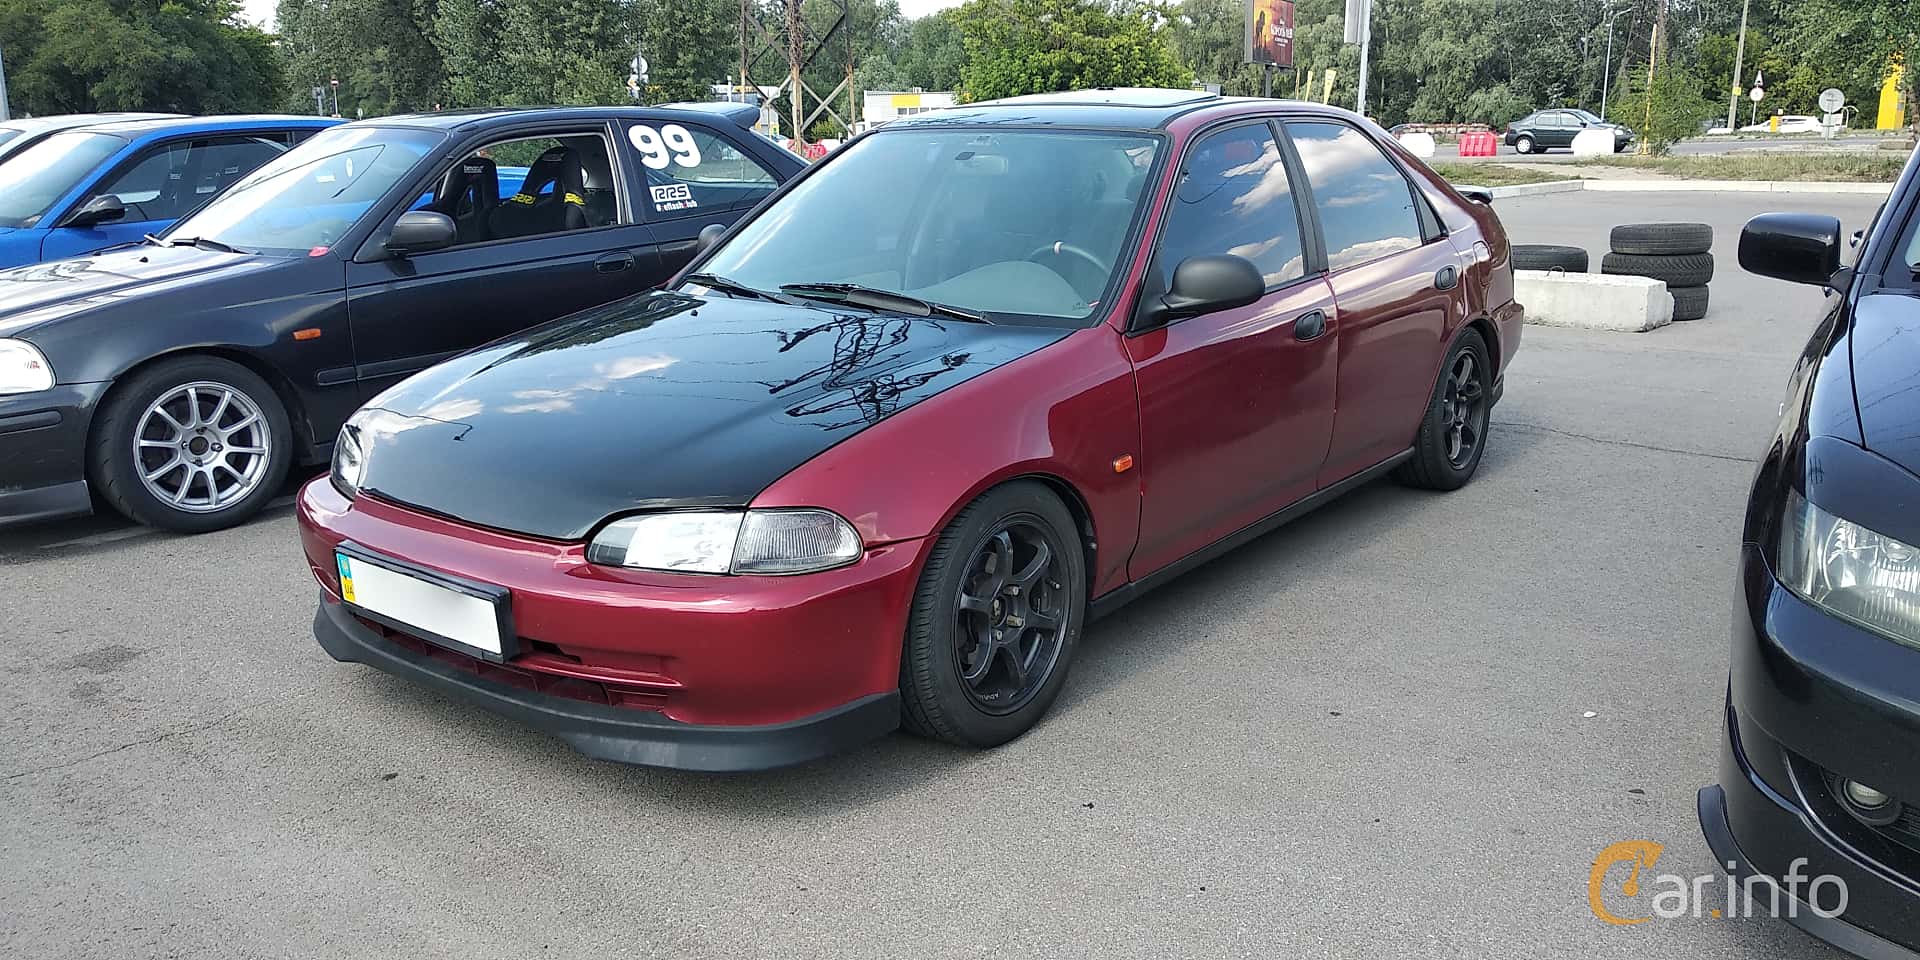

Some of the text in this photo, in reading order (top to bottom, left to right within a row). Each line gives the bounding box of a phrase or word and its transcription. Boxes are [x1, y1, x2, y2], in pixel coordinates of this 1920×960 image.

[628, 124, 701, 170] 99
[655, 186, 687, 200] RRS
[344, 583, 355, 595] UA
